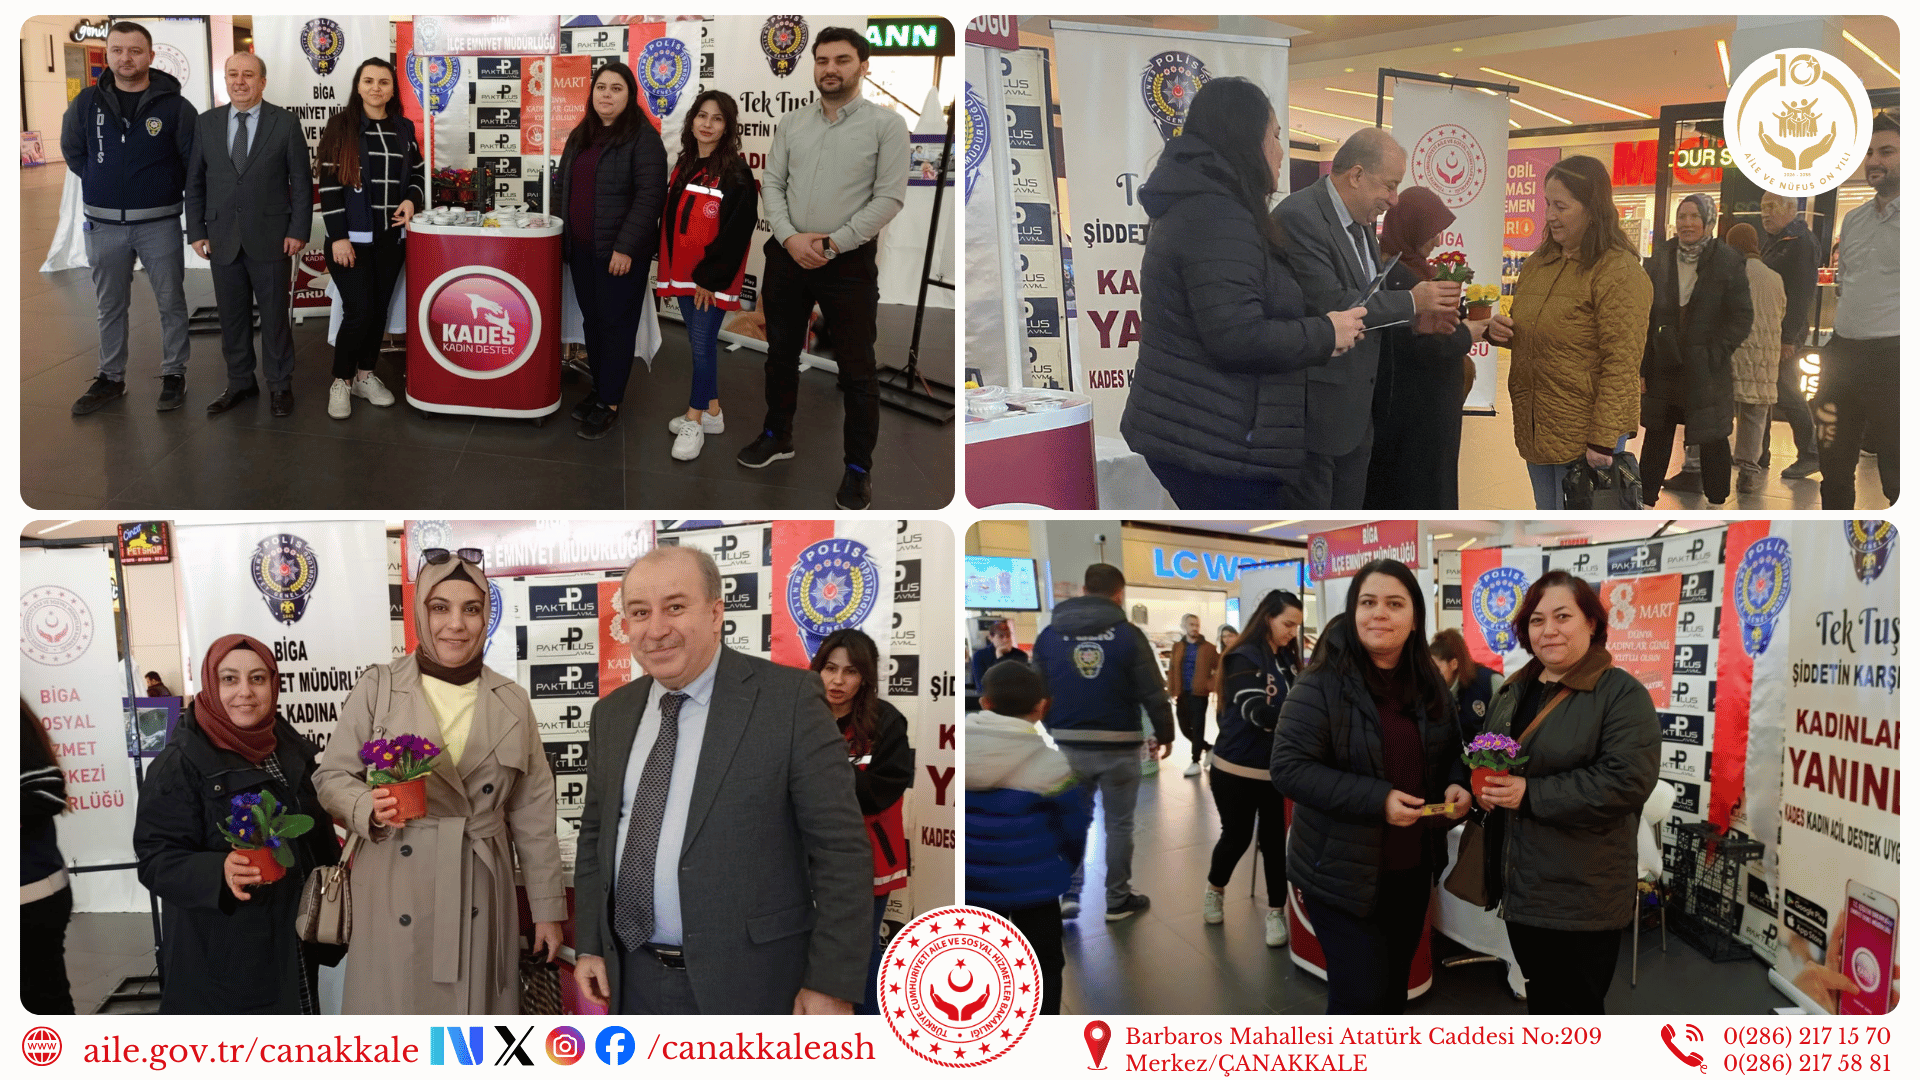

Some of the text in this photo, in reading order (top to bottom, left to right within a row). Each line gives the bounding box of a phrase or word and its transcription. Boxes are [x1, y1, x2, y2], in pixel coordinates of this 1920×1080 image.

[447, 33, 556, 53] İLÇE EMNİYET MÜDÜRLÜĞÜ
[649, 39, 682, 51] POLİS
[866, 24, 938, 48] ANN
[1155, 54, 1199, 70] POLİS
[313, 82, 335, 99] BİGA
[553, 77, 586, 89] MART
[739, 91, 775, 118] Tek
[442, 323, 516, 346] KADES
[442, 343, 515, 355] KADIN DESTEK
[1089, 370, 1125, 388] KADES
[263, 536, 302, 549] POLİS
[1362, 524, 1379, 545] BİGA
[807, 540, 861, 563] POLİS
[1153, 547, 1199, 579] LC
[1483, 569, 1521, 583] POLİS
[1608, 582, 1676, 630] 8 MART
[1816, 607, 1900, 656] Tek Tuş
[274, 636, 308, 661] BİGA
[1792, 659, 1850, 688] ŞİDDETİN
[40, 685, 81, 704] BİGA
[42, 715, 96, 731] OSYAL
[286, 702, 338, 724] KADINA
[1806, 810, 1830, 836] KADIN
[1830, 817, 1845, 844] ACİL
[1848, 825, 1882, 857] DESTEK
